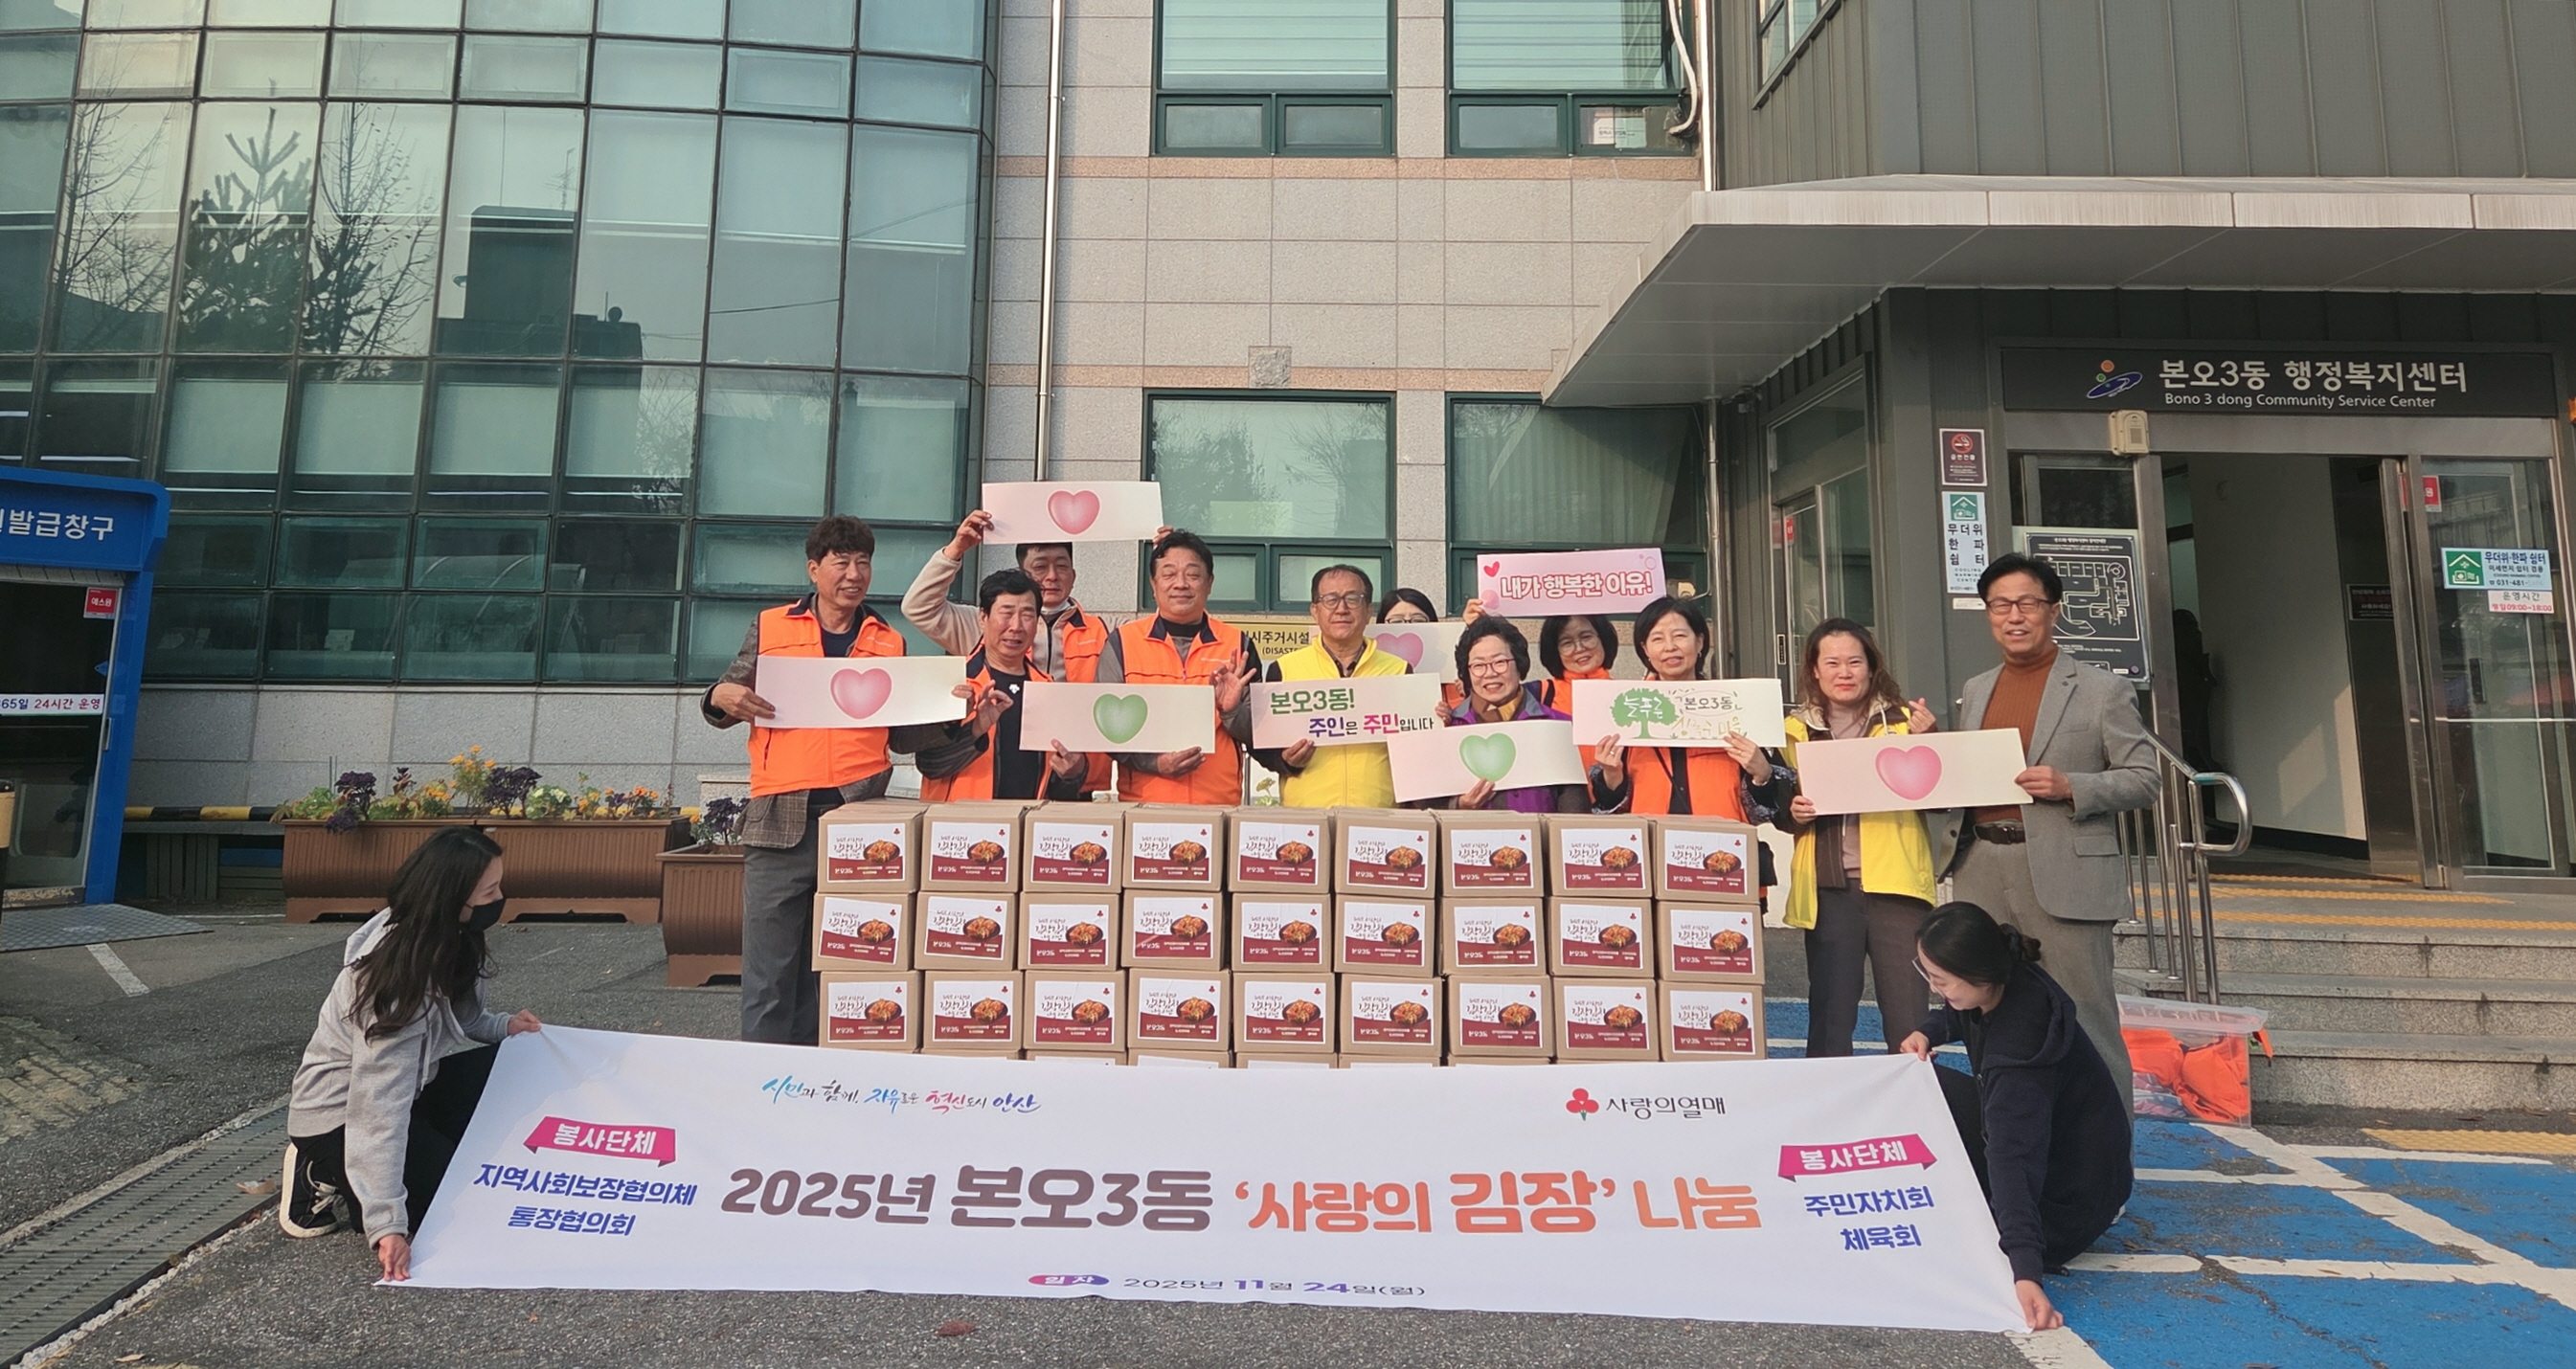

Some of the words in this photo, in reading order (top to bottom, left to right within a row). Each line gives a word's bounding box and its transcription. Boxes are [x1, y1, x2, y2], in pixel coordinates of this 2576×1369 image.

[2158, 360, 2270, 390] 본오3동
[2283, 360, 2468, 393] 행정복지센터
[2164, 393, 2200, 405] Bono
[2204, 393, 2212, 405] 3
[2217, 393, 2251, 408] dong
[2256, 393, 2334, 409] Community
[2339, 394, 2385, 407] Service
[2390, 396, 2435, 408] Center
[1948, 524, 1982, 535] 무더위
[2485, 551, 2527, 564] 무더위·한파
[2530, 552, 2546, 565] 쉼터
[1501, 575, 1541, 599] 내가
[1544, 573, 1602, 598] 행복한
[1606, 572, 1653, 595] 이유!
[2503, 592, 2541, 601] 운영시간
[91, 597, 113, 607] 에스원
[0, 699, 29, 710] 65일
[34, 699, 74, 710] 24시간
[79, 699, 101, 710] 운영
[1271, 688, 1355, 714] 본오3동!
[1623, 695, 1663, 719] 늘푸른
[1683, 696, 1733, 710] 본오3동
[1308, 716, 1358, 737] 주인은
[1363, 713, 1435, 734] 주민입니다
[761, 1075, 819, 1104] 시민과
[863, 1088, 919, 1114] 자유로운
[925, 1090, 986, 1115] 혁신도시
[992, 1092, 1042, 1113] 안산
[1606, 1094, 1727, 1119] 사랑의열매
[554, 1124, 656, 1156] 봉사단체
[1799, 1140, 1909, 1173] 봉사단체
[473, 1163, 697, 1207] 지역사회보장협의체
[722, 1167, 937, 1223] 2025년
[952, 1165, 1212, 1233] 본오3동
[1233, 1180, 1431, 1233] ‘사랑의
[1450, 1170, 1617, 1234] 김장’
[1637, 1177, 1762, 1230] 나눔
[1804, 1185, 1935, 1218] 주민자치회
[507, 1205, 634, 1238] 통장협의회
[1842, 1223, 1923, 1251] 체육회
[1123, 1278, 1223, 1290] 2025년
[1234, 1279, 1292, 1292] 11월
[1303, 1282, 1426, 1296] 24일(월)
